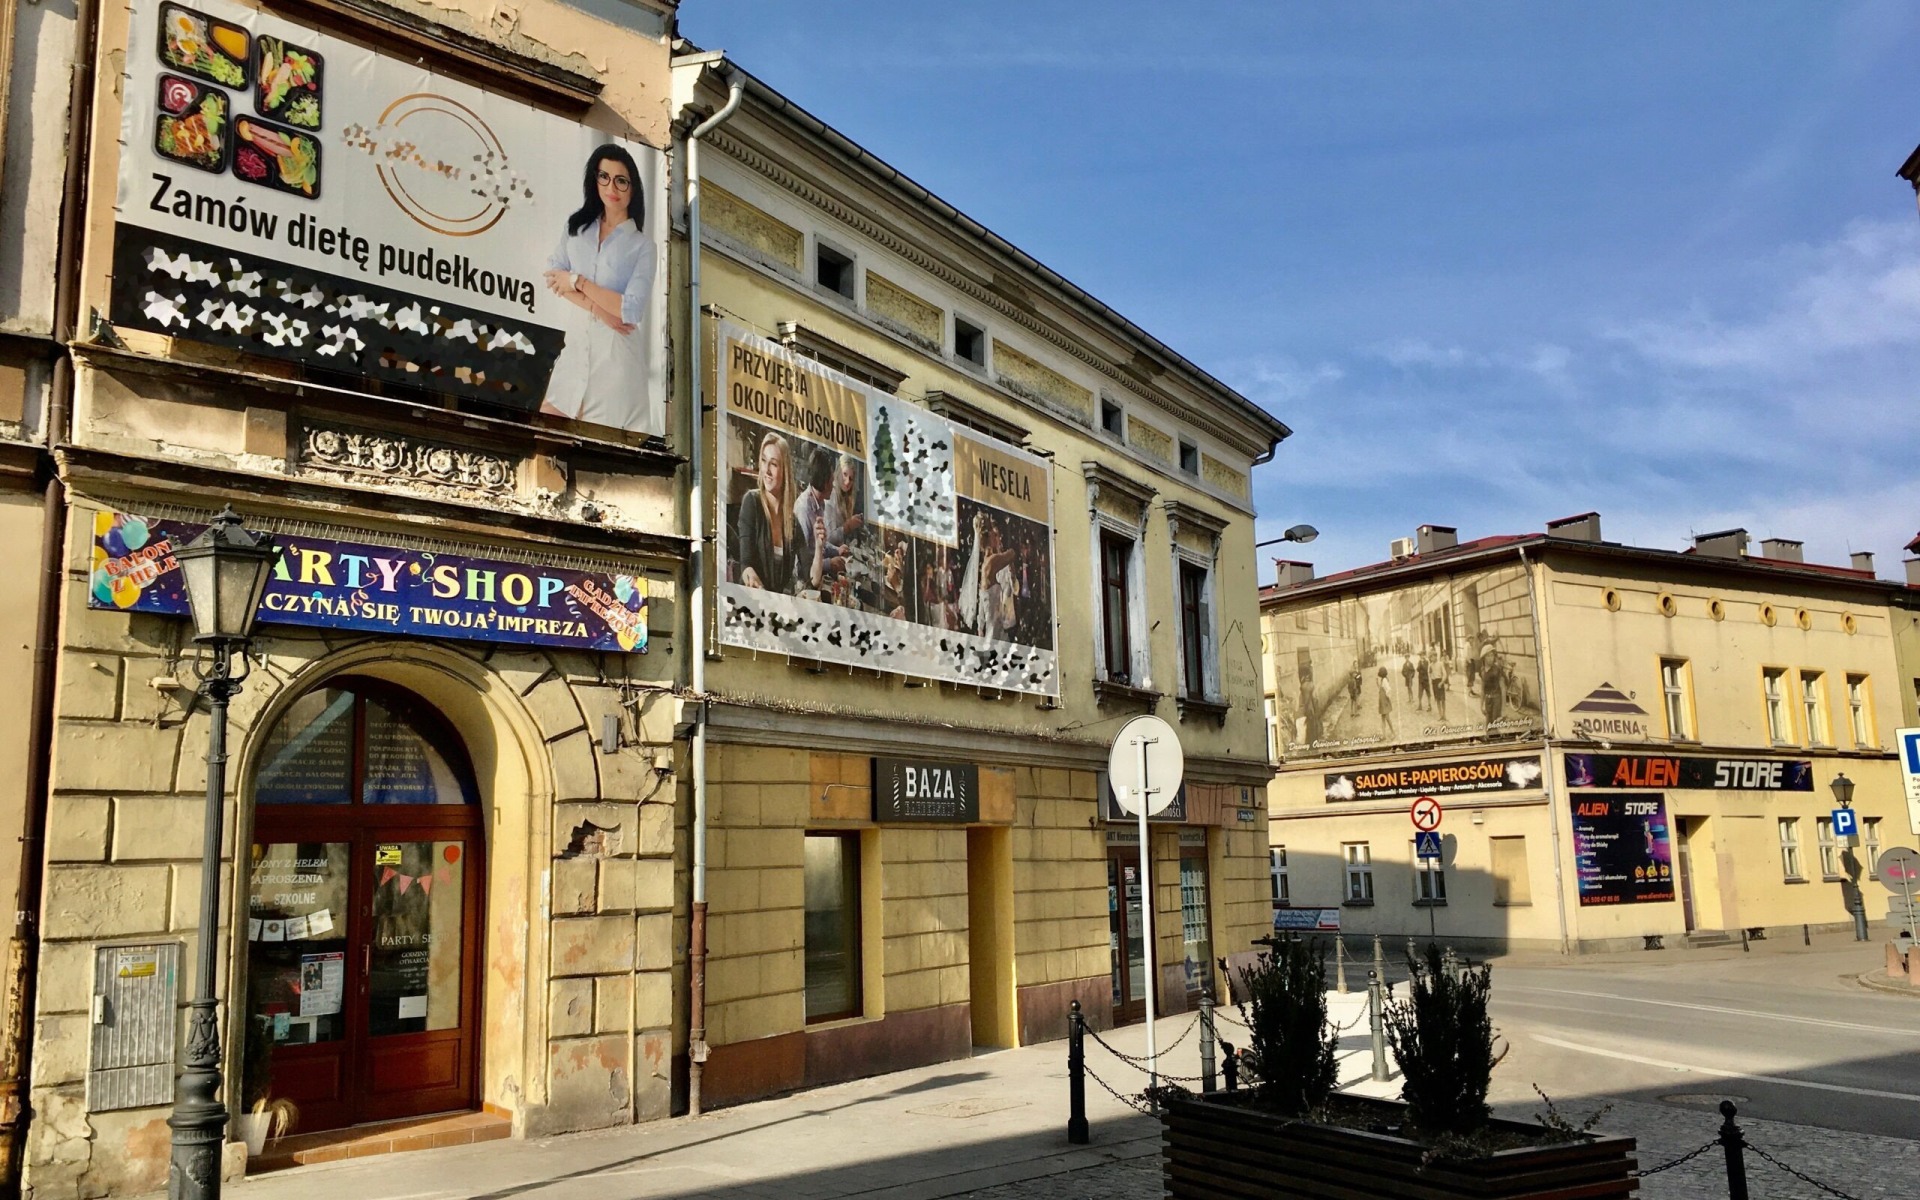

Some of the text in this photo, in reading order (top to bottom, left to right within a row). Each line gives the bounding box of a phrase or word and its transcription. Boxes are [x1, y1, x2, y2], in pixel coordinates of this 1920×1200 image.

[150, 173, 278, 240] Zamów
[287, 213, 370, 272] dietę
[378, 242, 536, 313] pudełkową
[733, 345, 808, 397] PRZYJĘCIA
[733, 382, 862, 453] OKOLICZNOŚCIOWE
[979, 457, 1031, 502] WESELA
[105, 540, 172, 576] BALON
[109, 555, 180, 594] Z HELE
[272, 546, 566, 608] ARTY SHOP
[258, 593, 589, 639] CZYNA SIĘ TWOJA IMPREZA
[1487, 716, 1533, 730] photography
[905, 766, 955, 799] BAZA
[1356, 762, 1504, 789] SALON E-PAPIEROSÓW
[1612, 758, 1784, 788] ALIEN STORE
[1577, 802, 1658, 816] ALIEN STORE
[293, 859, 328, 868] HELEM
[274, 892, 316, 906] SZKOLNE
[381, 935, 415, 946] PARTY
